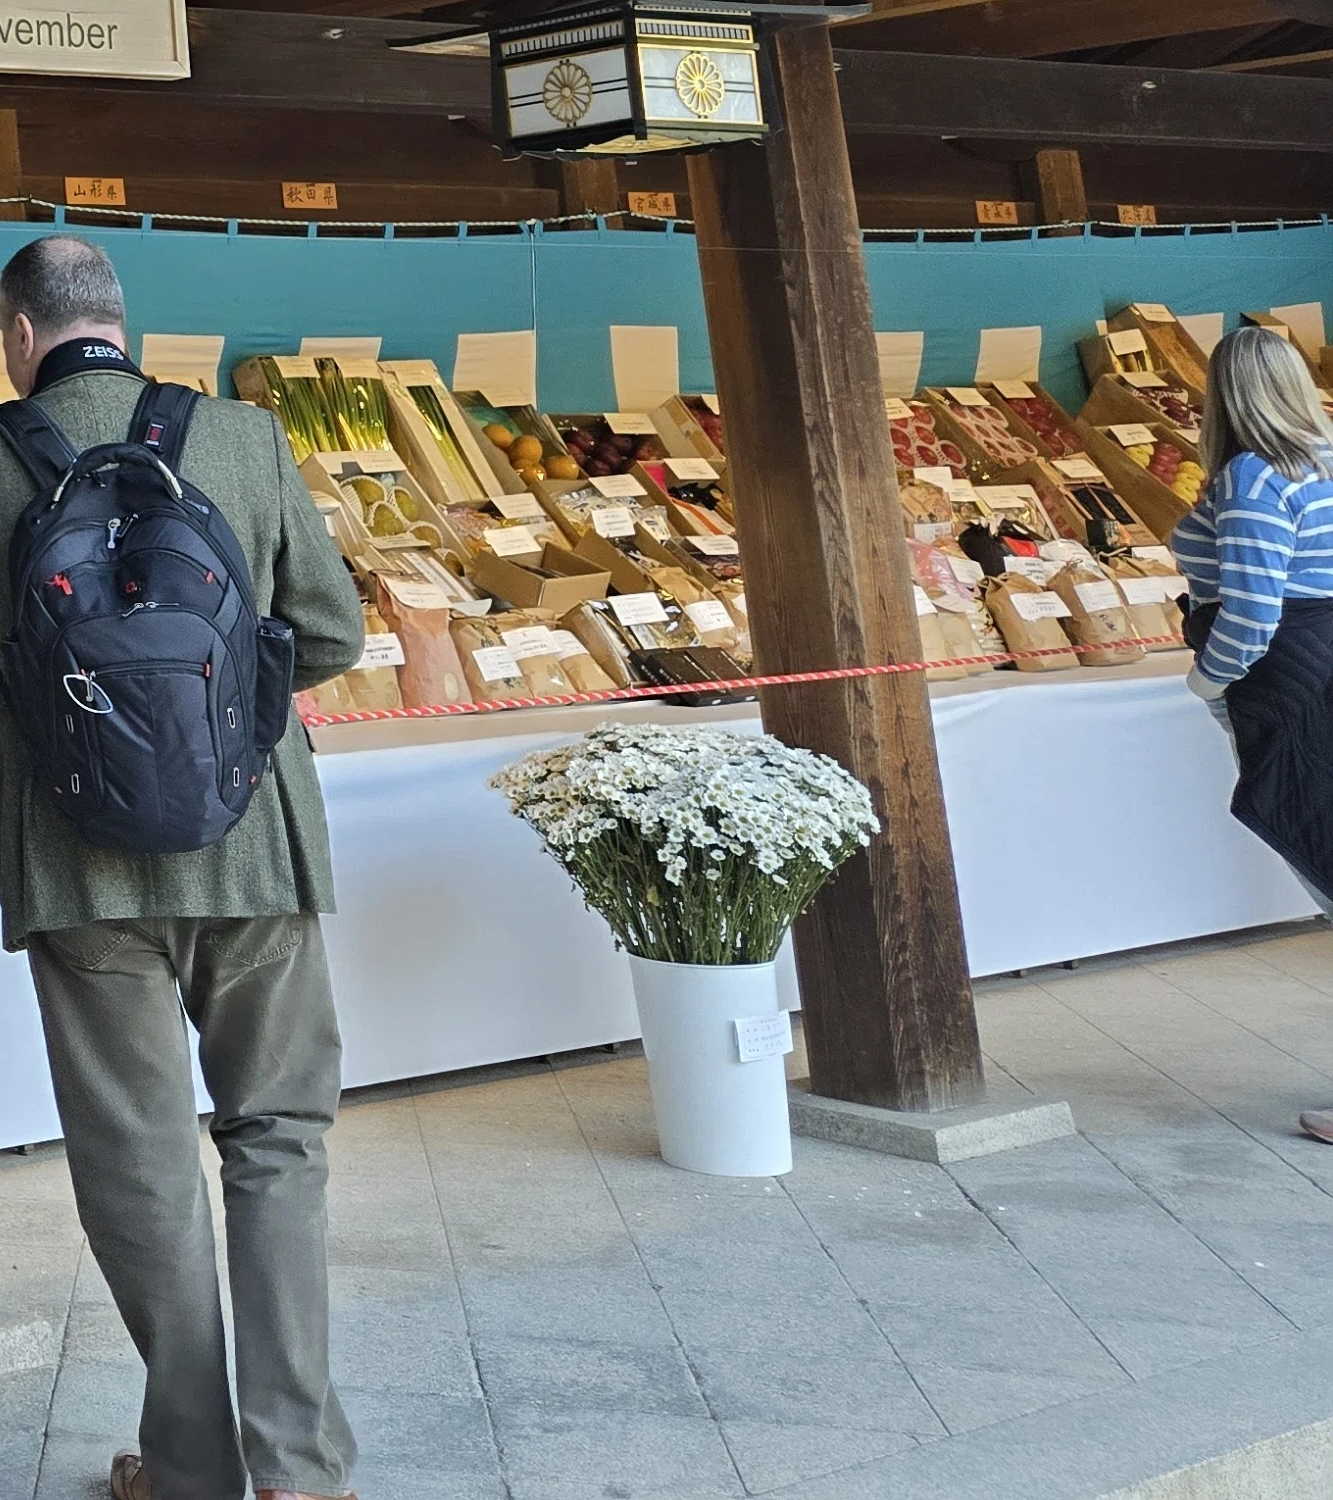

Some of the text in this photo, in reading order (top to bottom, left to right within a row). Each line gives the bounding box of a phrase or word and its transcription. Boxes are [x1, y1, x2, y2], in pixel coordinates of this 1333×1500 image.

[73, 184, 117, 201] 山形県
[286, 186, 334, 205] 秋田県
[82, 345, 124, 361] ZEISS
